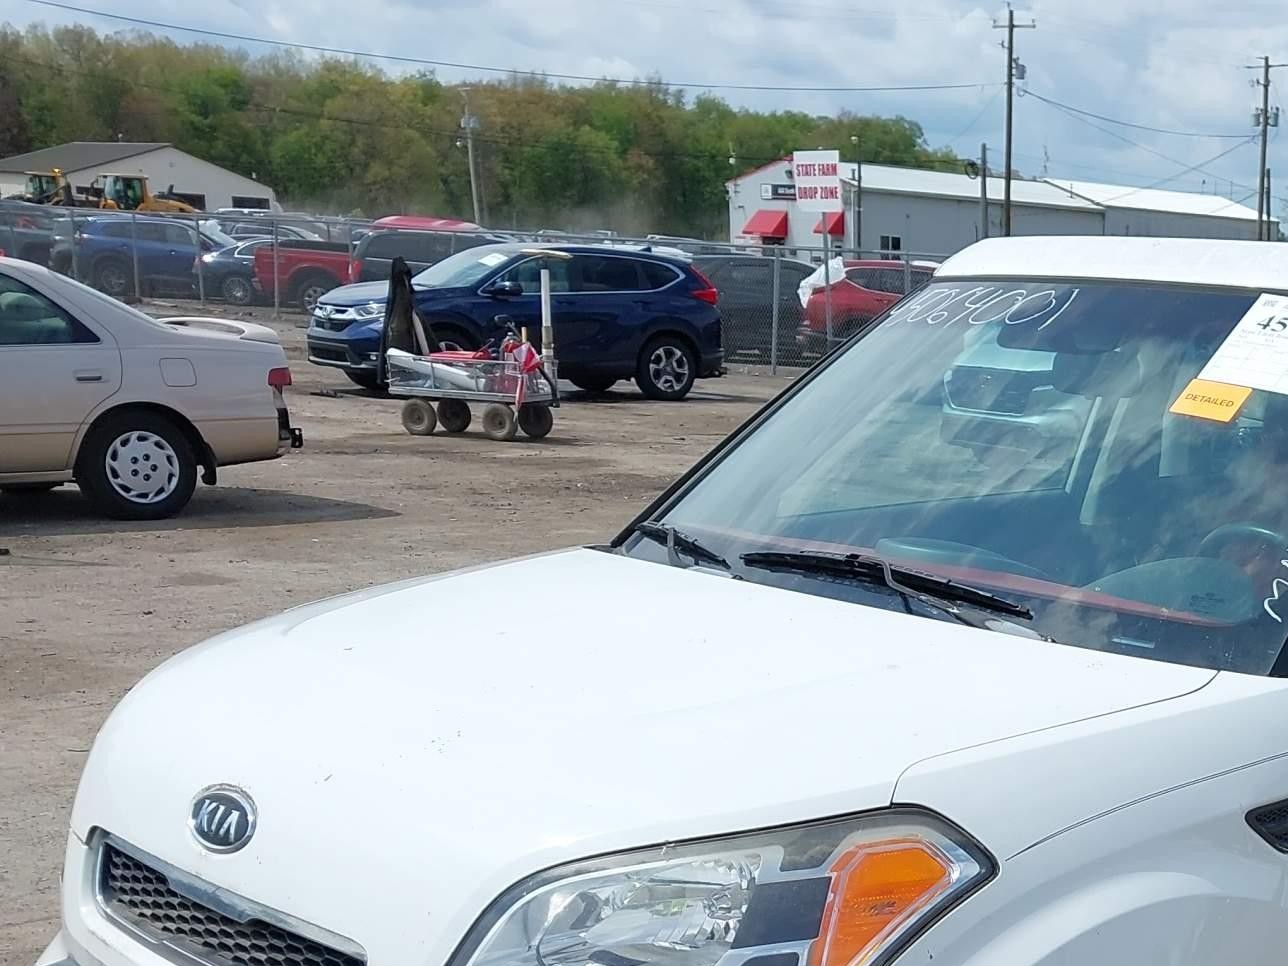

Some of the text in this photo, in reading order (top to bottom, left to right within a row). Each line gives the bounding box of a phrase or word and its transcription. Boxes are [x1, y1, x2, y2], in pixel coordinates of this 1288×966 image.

[796, 163, 837, 176] STATE FARM
[798, 187, 818, 199] DROP
[820, 187, 839, 199] ZONE
[1185, 393, 1234, 408] DETAILED
[197, 799, 241, 843] KIA
